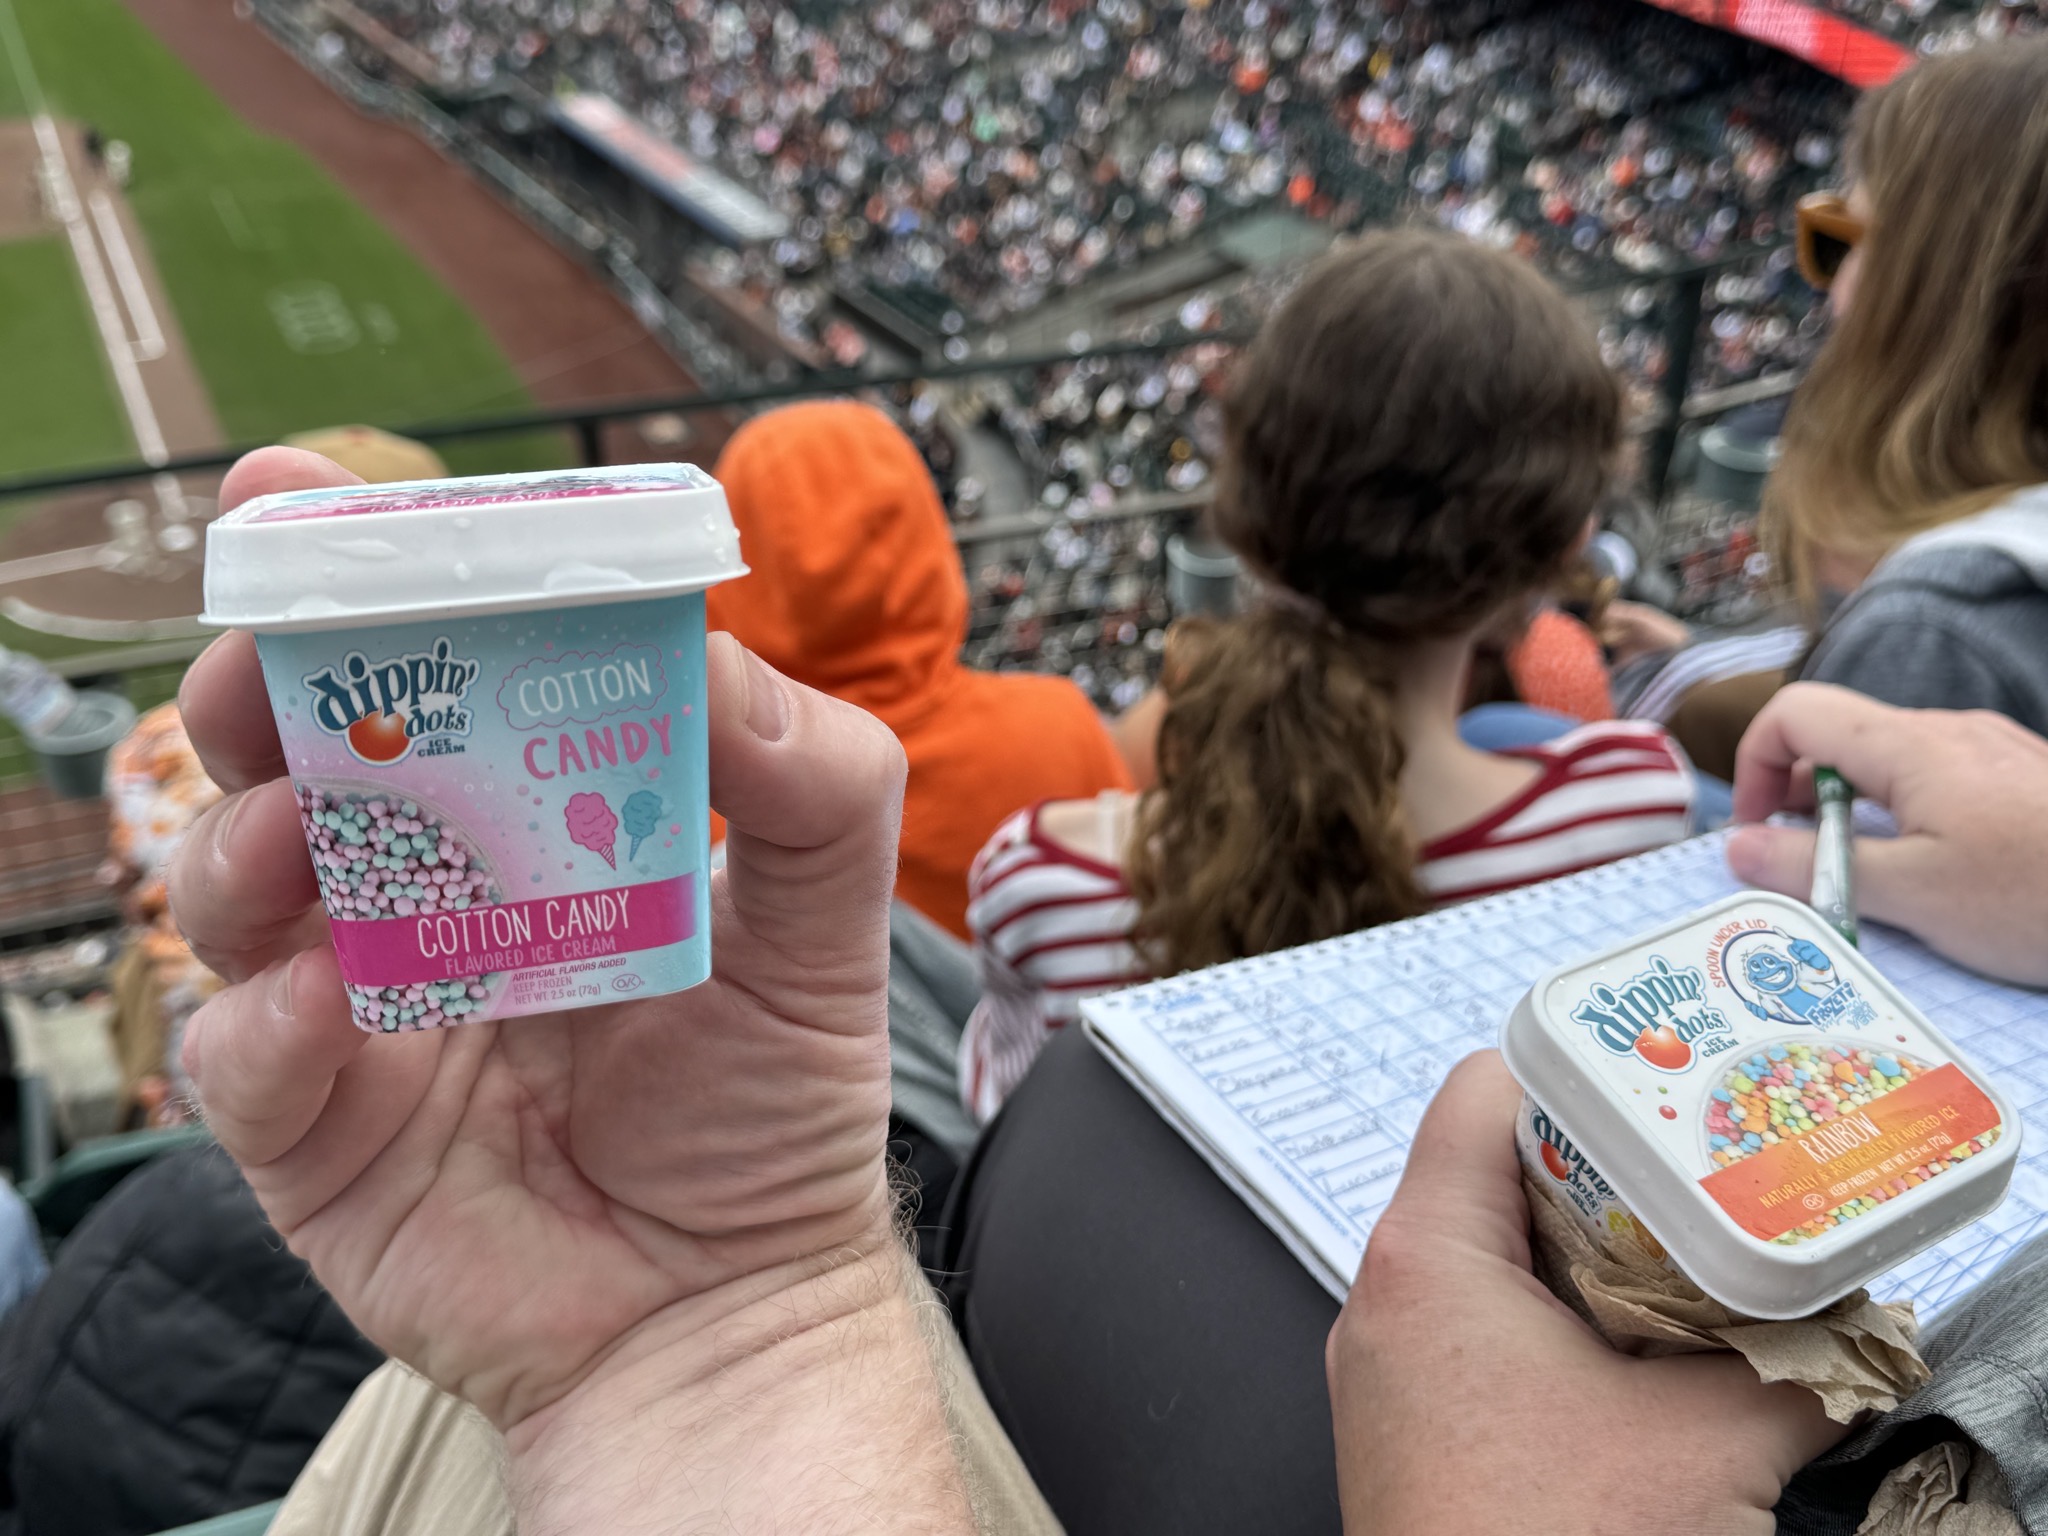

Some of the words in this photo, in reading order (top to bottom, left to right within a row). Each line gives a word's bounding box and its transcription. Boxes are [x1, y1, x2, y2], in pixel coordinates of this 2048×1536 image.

[519, 658, 652, 717] COTTON
[405, 704, 468, 738] dots
[417, 745, 466, 758] CREAM
[428, 738, 452, 748] ICE
[523, 713, 671, 781] CANDY
[417, 905, 532, 959] COTTON
[546, 889, 630, 941] CANDY
[1710, 921, 1745, 947] UNDER
[1745, 919, 1768, 929] LID
[445, 949, 524, 976] FLAVORED
[531, 945, 555, 964] ICE
[562, 935, 617, 960] CREAM
[513, 968, 557, 982] ARTIFICIAL
[559, 962, 597, 975] FLAVORS
[598, 957, 627, 969] ADDED
[1706, 948, 1726, 988] SPOON
[513, 981, 536, 994] KEEP
[539, 976, 573, 990] FROZEN
[514, 994, 533, 1005] NET
[578, 983, 601, 998] (72g)
[1671, 1008, 1725, 1043] dots
[1704, 1036, 1725, 1048] ICE
[1702, 1038, 1739, 1058] CREAM
[1798, 1111, 1882, 1165] RAINBOW
[1759, 1173, 1819, 1209] NATURALLY
[1816, 1169, 1831, 1180] &
[1829, 1138, 1893, 1177] ARTIFICIALLY
[1890, 1114, 1941, 1145] FLAVORED
[1938, 1105, 1960, 1121] ICE
[1565, 1171, 1598, 1209] dots
[1829, 1180, 1850, 1198] KEEP
[1848, 1168, 1880, 1189] FROZEN
[1877, 1159, 1898, 1174] NET
